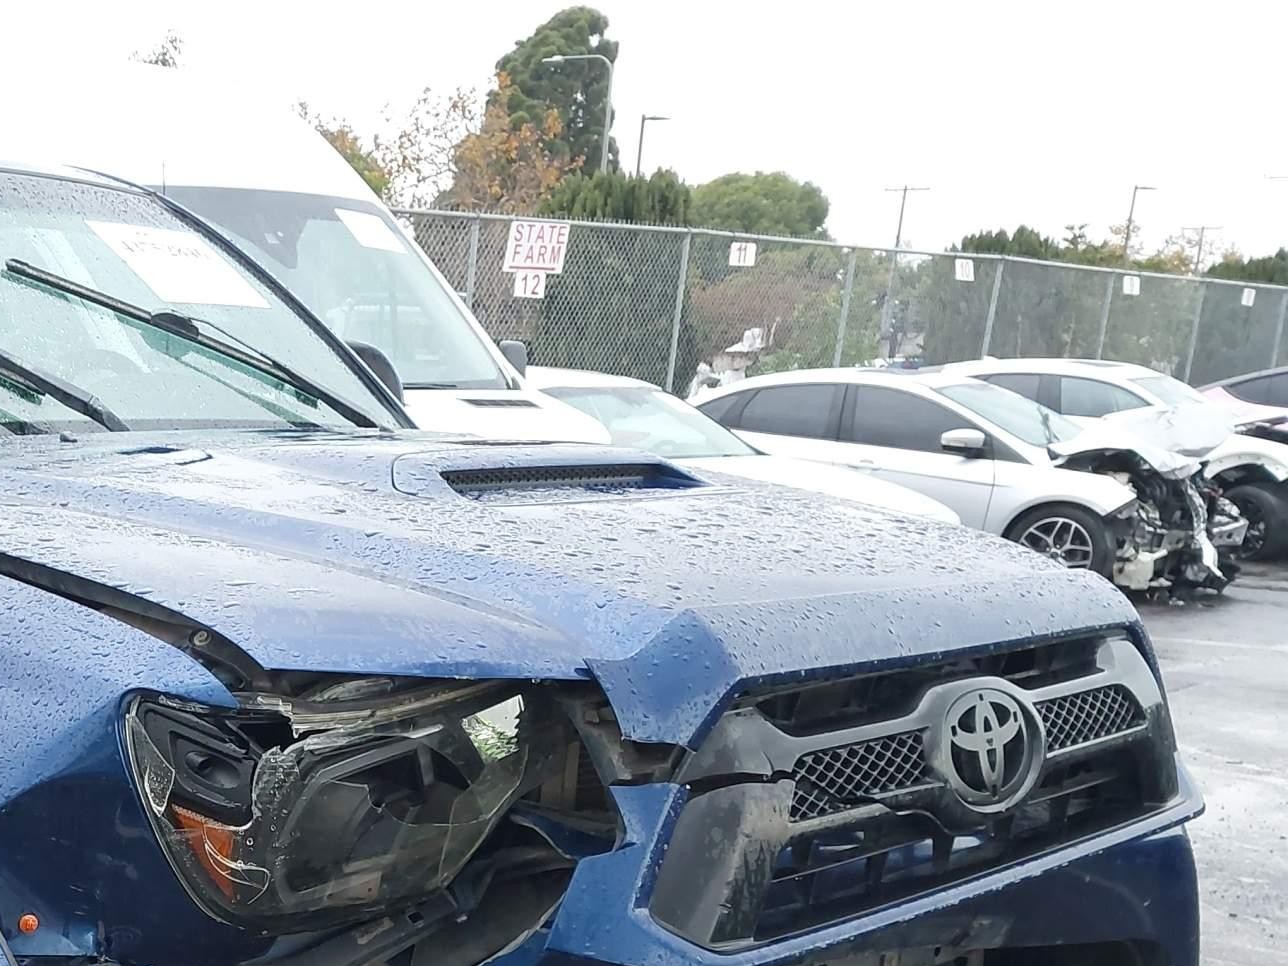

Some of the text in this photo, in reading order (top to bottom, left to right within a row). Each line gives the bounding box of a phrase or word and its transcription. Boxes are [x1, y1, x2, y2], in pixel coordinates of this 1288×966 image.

[514, 223, 568, 245] STATE
[512, 244, 562, 264] FARM
[736, 243, 748, 264] 11
[521, 273, 541, 295] 12
